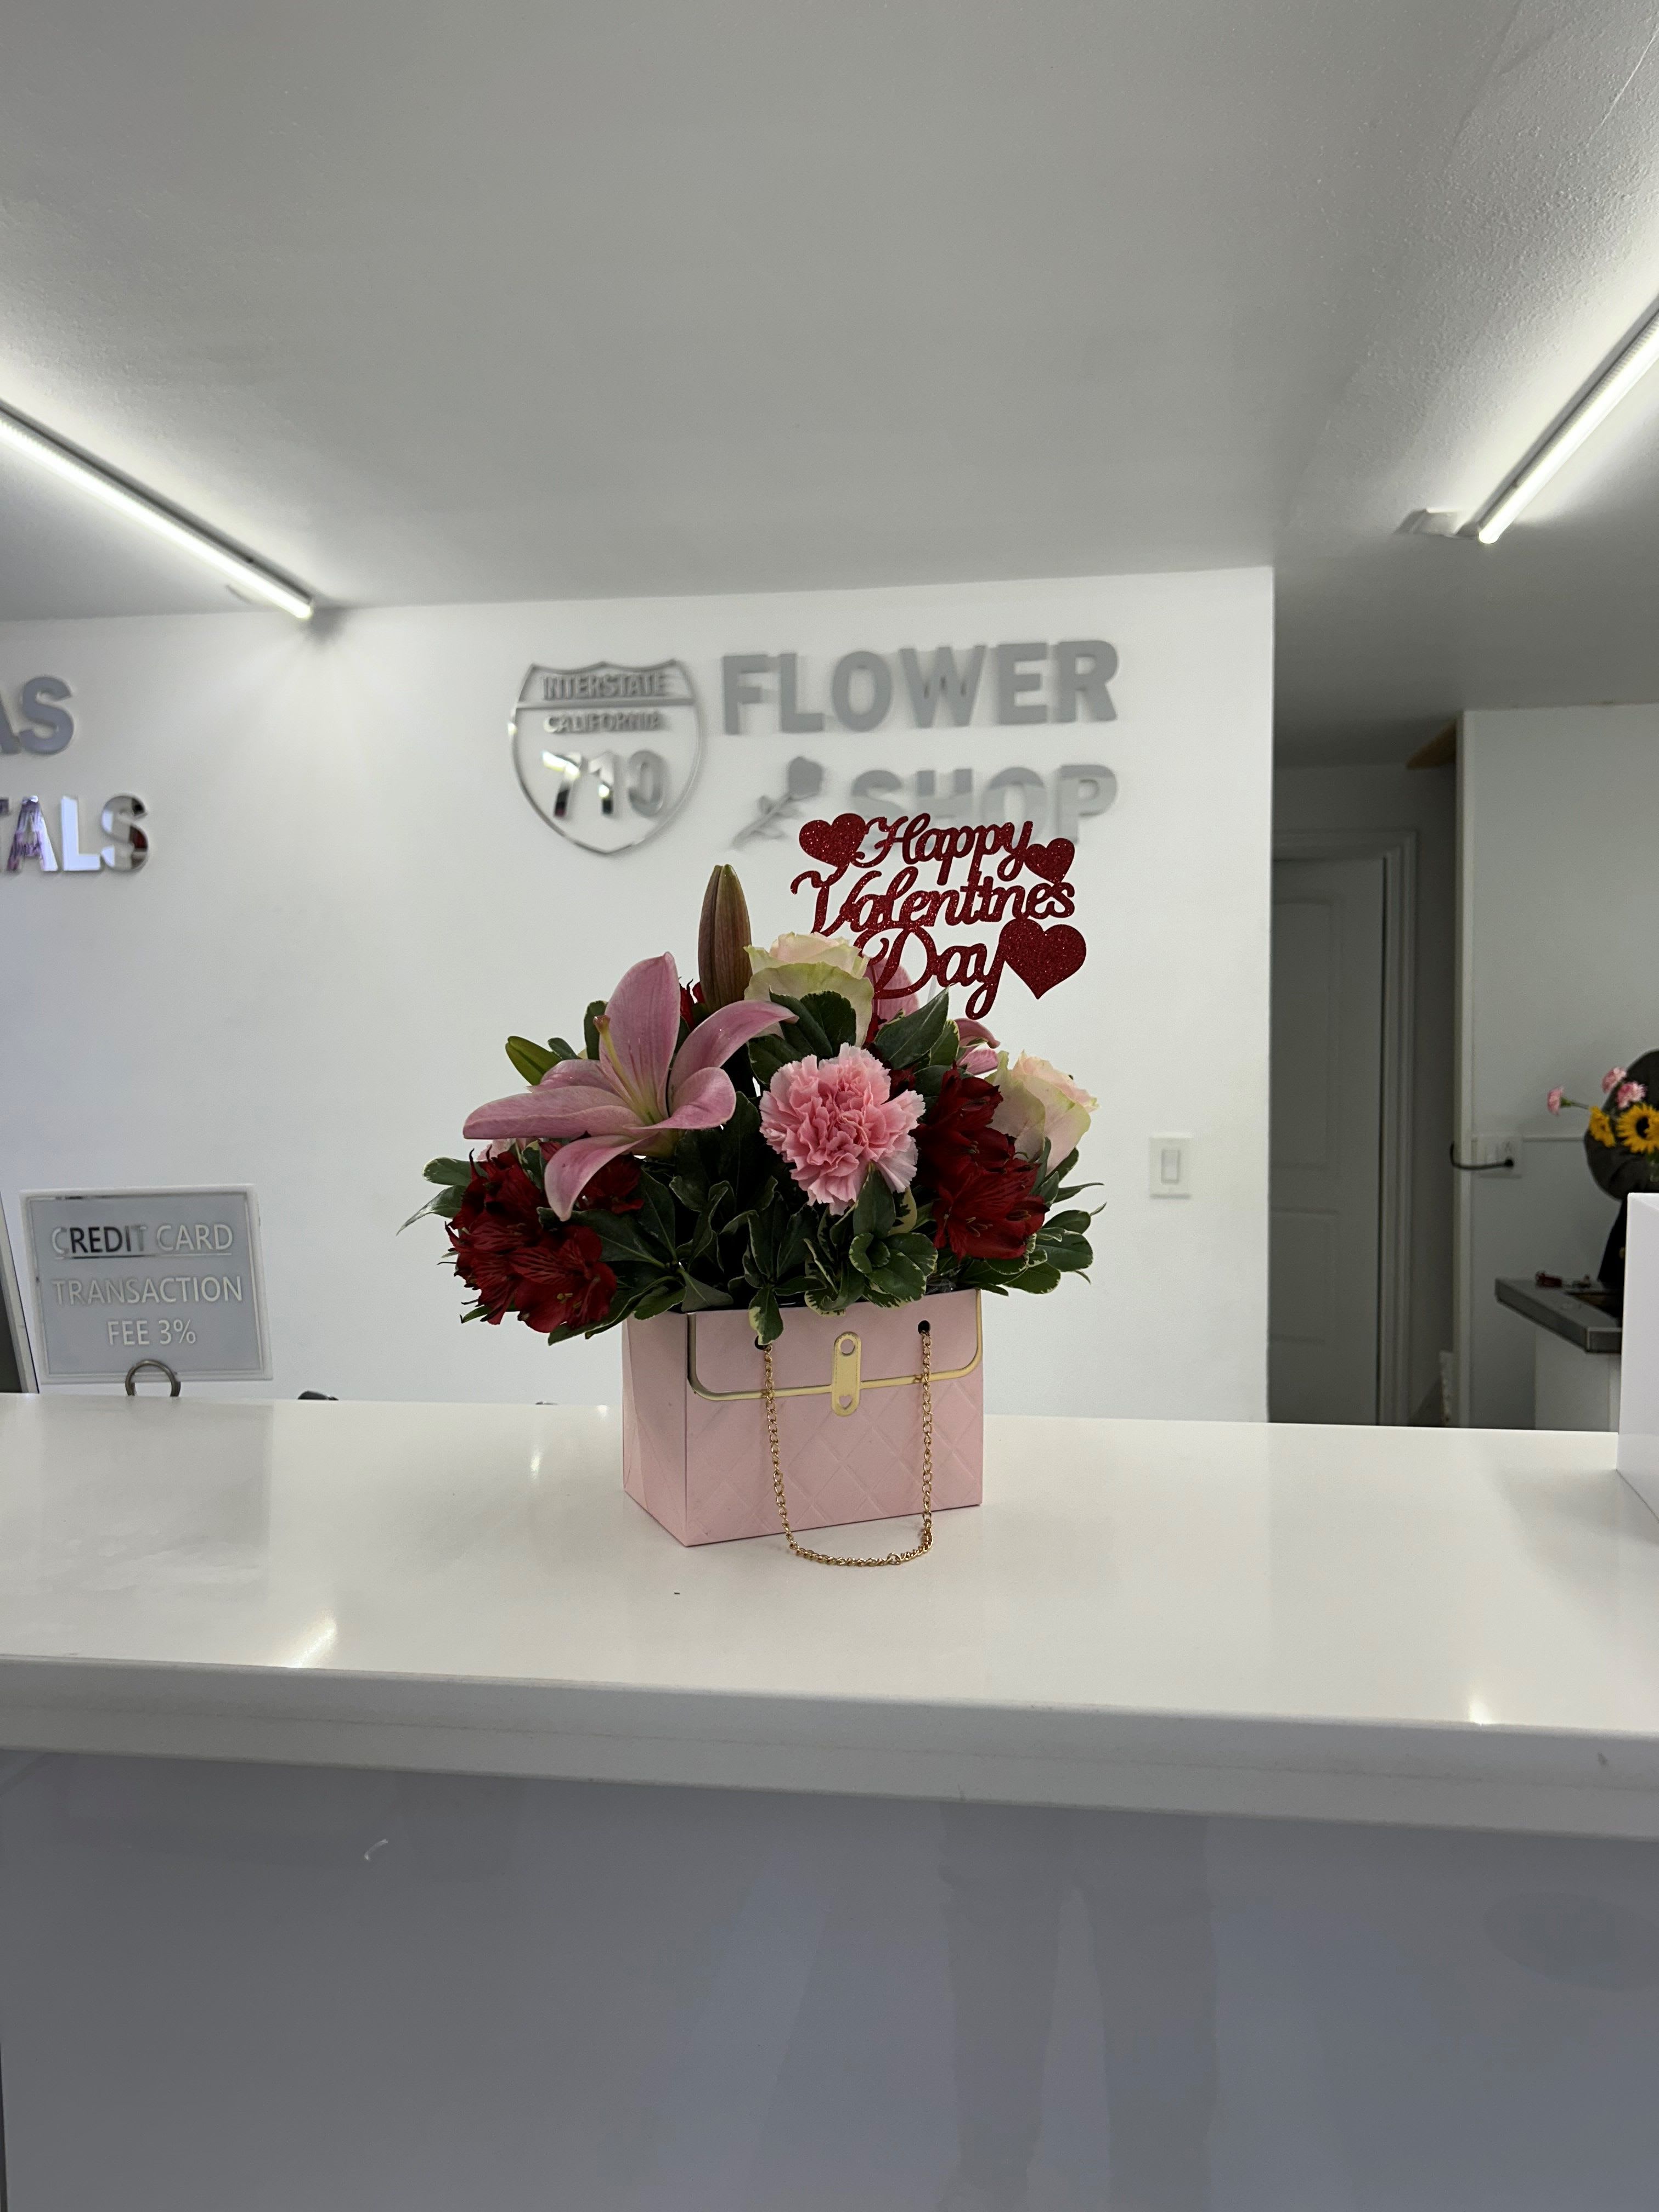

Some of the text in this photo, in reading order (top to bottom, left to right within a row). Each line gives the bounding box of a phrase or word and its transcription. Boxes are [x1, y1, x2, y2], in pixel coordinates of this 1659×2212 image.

[543, 673, 665, 701] INTERSTATE
[721, 640, 1118, 735] FLOWER
[543, 713, 663, 733] CALIFORNIA
[540, 749, 665, 817] 710
[851, 764, 1118, 851] SHOP
[0, 795, 149, 872] ALS
[851, 812, 1033, 885] Happy
[790, 866, 1075, 936] Valentines
[853, 925, 1011, 1019] Day
[52, 1224, 234, 1254] CREDIT CARD
[52, 1276, 243, 1305] TRANSACTION
[107, 1319, 196, 1346] FEE 3%
